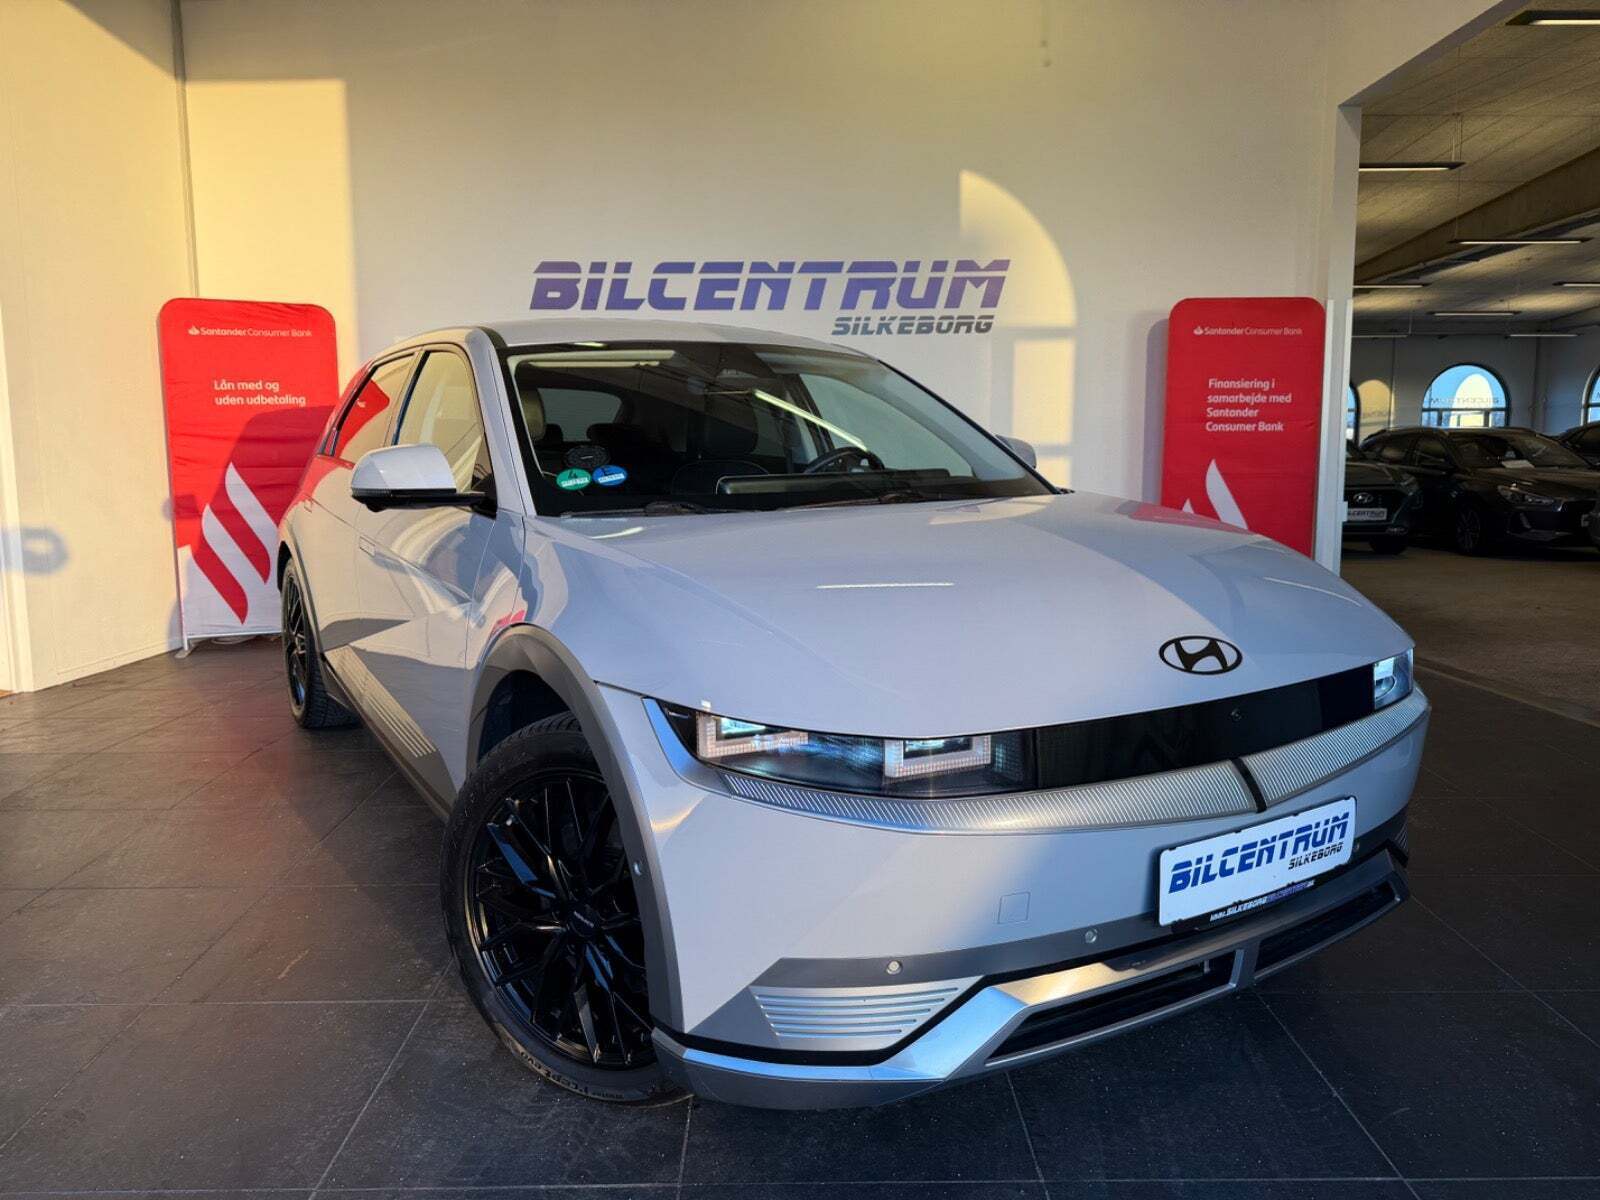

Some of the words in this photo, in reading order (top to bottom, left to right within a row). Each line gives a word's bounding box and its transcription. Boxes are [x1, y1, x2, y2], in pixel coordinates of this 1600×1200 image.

[529, 259, 1011, 311] BILCENTRUM
[200, 327, 246, 337] Santander
[247, 328, 290, 337] Consumer
[291, 328, 313, 337] Bank
[831, 315, 995, 336] SILKEBORG
[1204, 326, 1244, 336] Santander
[1245, 327, 1283, 336] Consumer
[1284, 327, 1304, 336] Bank
[214, 379, 234, 390] Lån
[237, 380, 263, 390] med
[265, 382, 280, 392] og
[1208, 378, 1270, 391] Finansiering
[214, 395, 244, 405] uden
[246, 395, 307, 408] udbetaling
[1207, 392, 1267, 406] samarbejde
[1269, 392, 1292, 404] med
[1206, 407, 1260, 418] Santander
[1205, 421, 1256, 432] Consumer
[1258, 421, 1284, 432] Bank
[1168, 812, 1350, 894] BILCENTRUM
[1288, 842, 1344, 870] SILKEBORG
